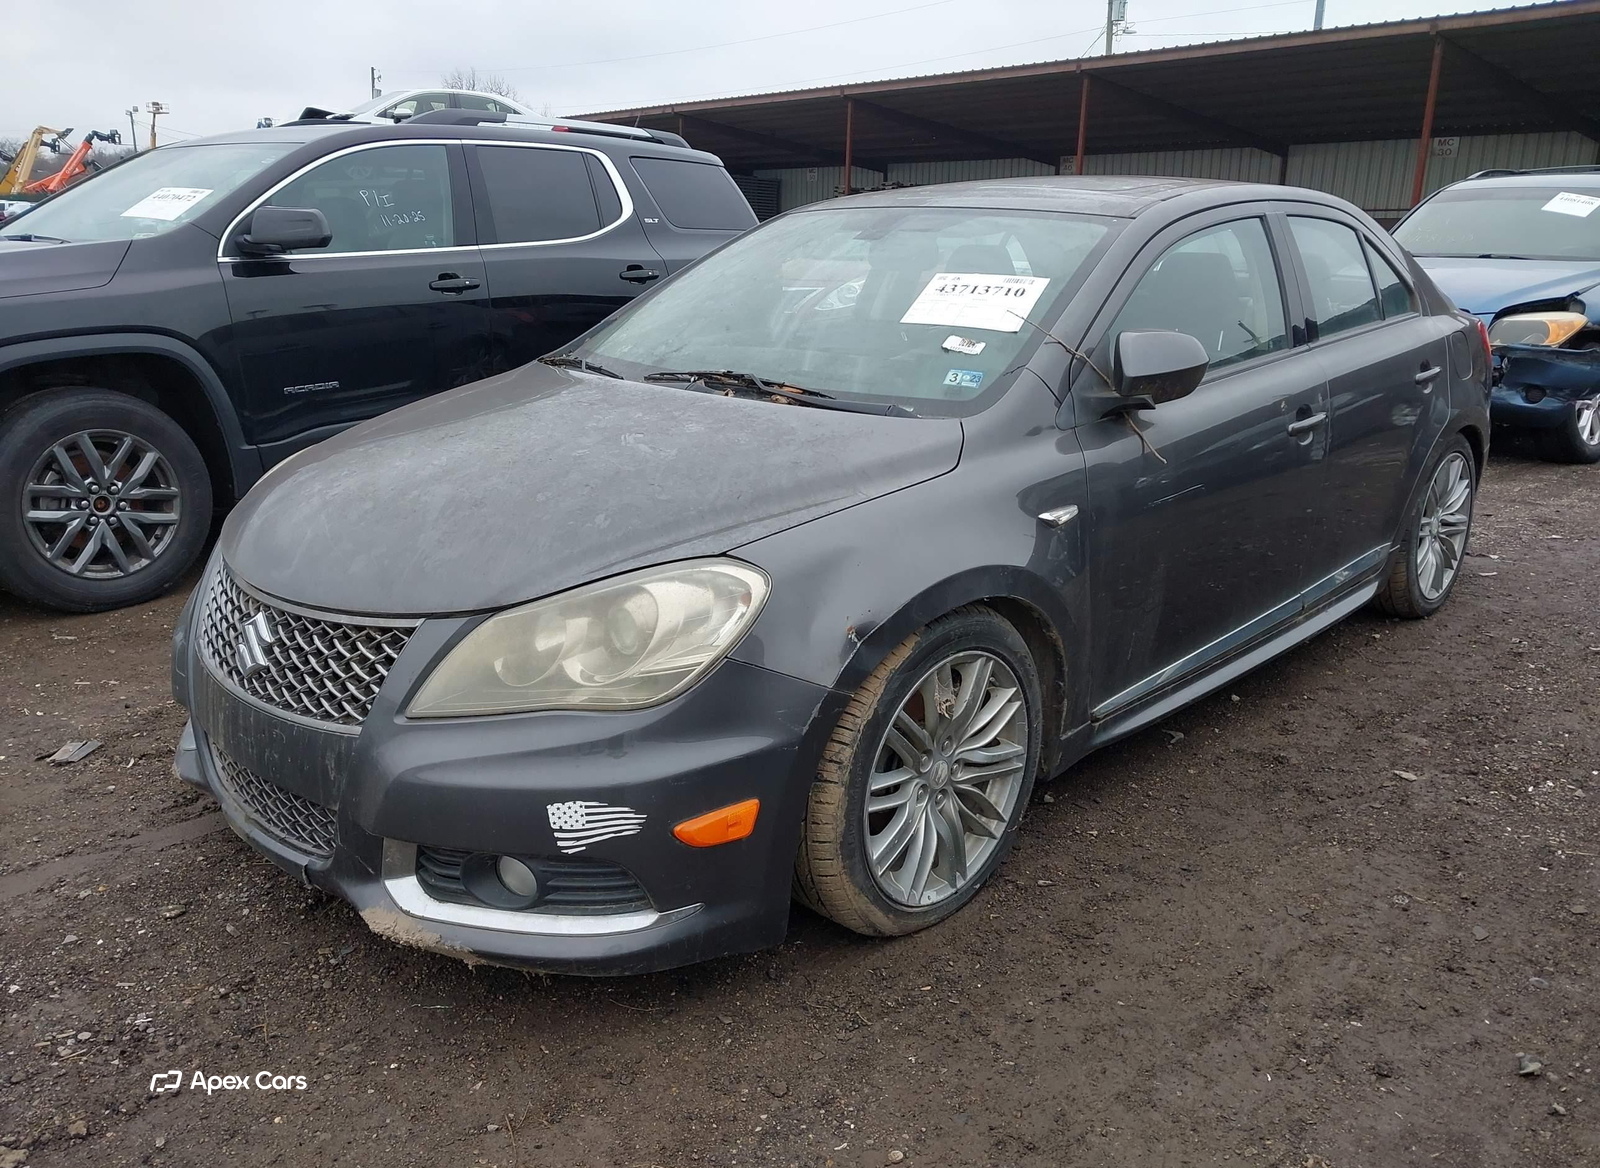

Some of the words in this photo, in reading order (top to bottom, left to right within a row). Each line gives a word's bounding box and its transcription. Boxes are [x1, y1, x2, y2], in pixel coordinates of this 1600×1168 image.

[1437, 138, 1455, 147] MC
[1437, 148, 1453, 157] 30
[935, 283, 1027, 298] 43713710
[948, 372, 959, 383] 3
[970, 374, 982, 383] 23
[283, 381, 340, 395] ACADIA
